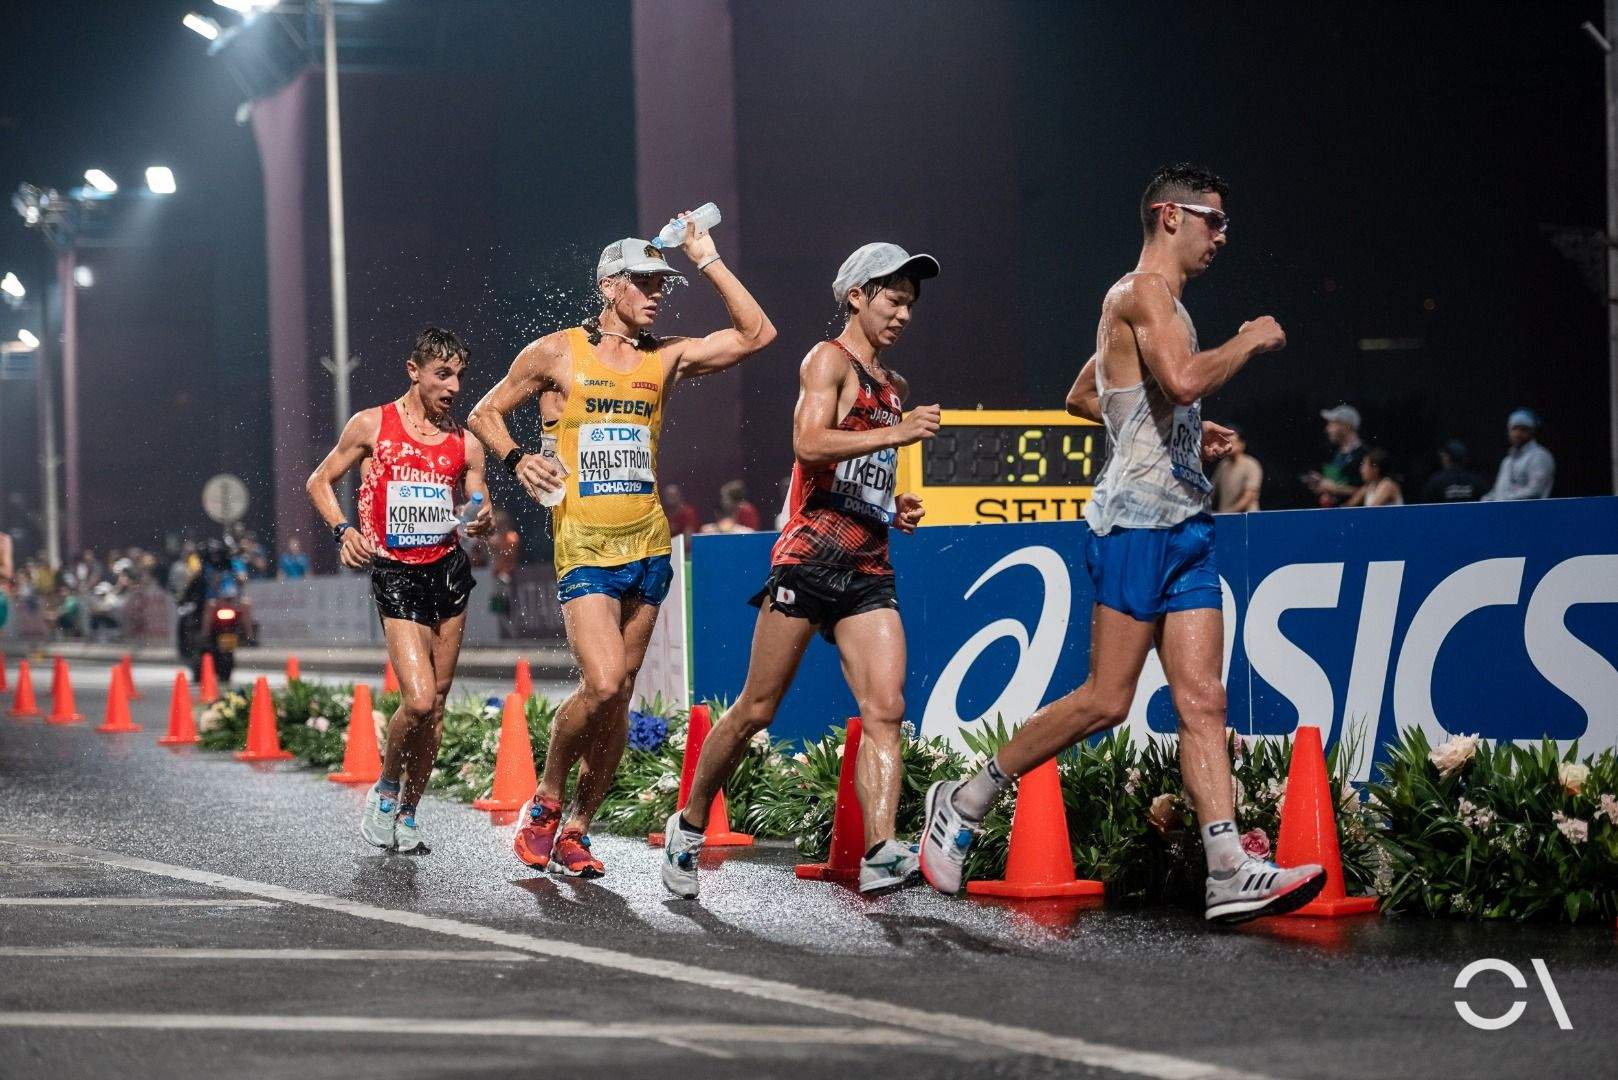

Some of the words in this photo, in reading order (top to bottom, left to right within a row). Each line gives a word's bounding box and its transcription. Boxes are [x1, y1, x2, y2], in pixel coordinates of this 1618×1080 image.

[585, 398, 654, 419] SWEDEN
[604, 428, 642, 442] TDK
[580, 447, 650, 470] KARLSTRÖM
[579, 469, 610, 481] 1710
[844, 459, 894, 497] IKEDA
[411, 486, 446, 500] TDK
[388, 523, 415, 533] 1776
